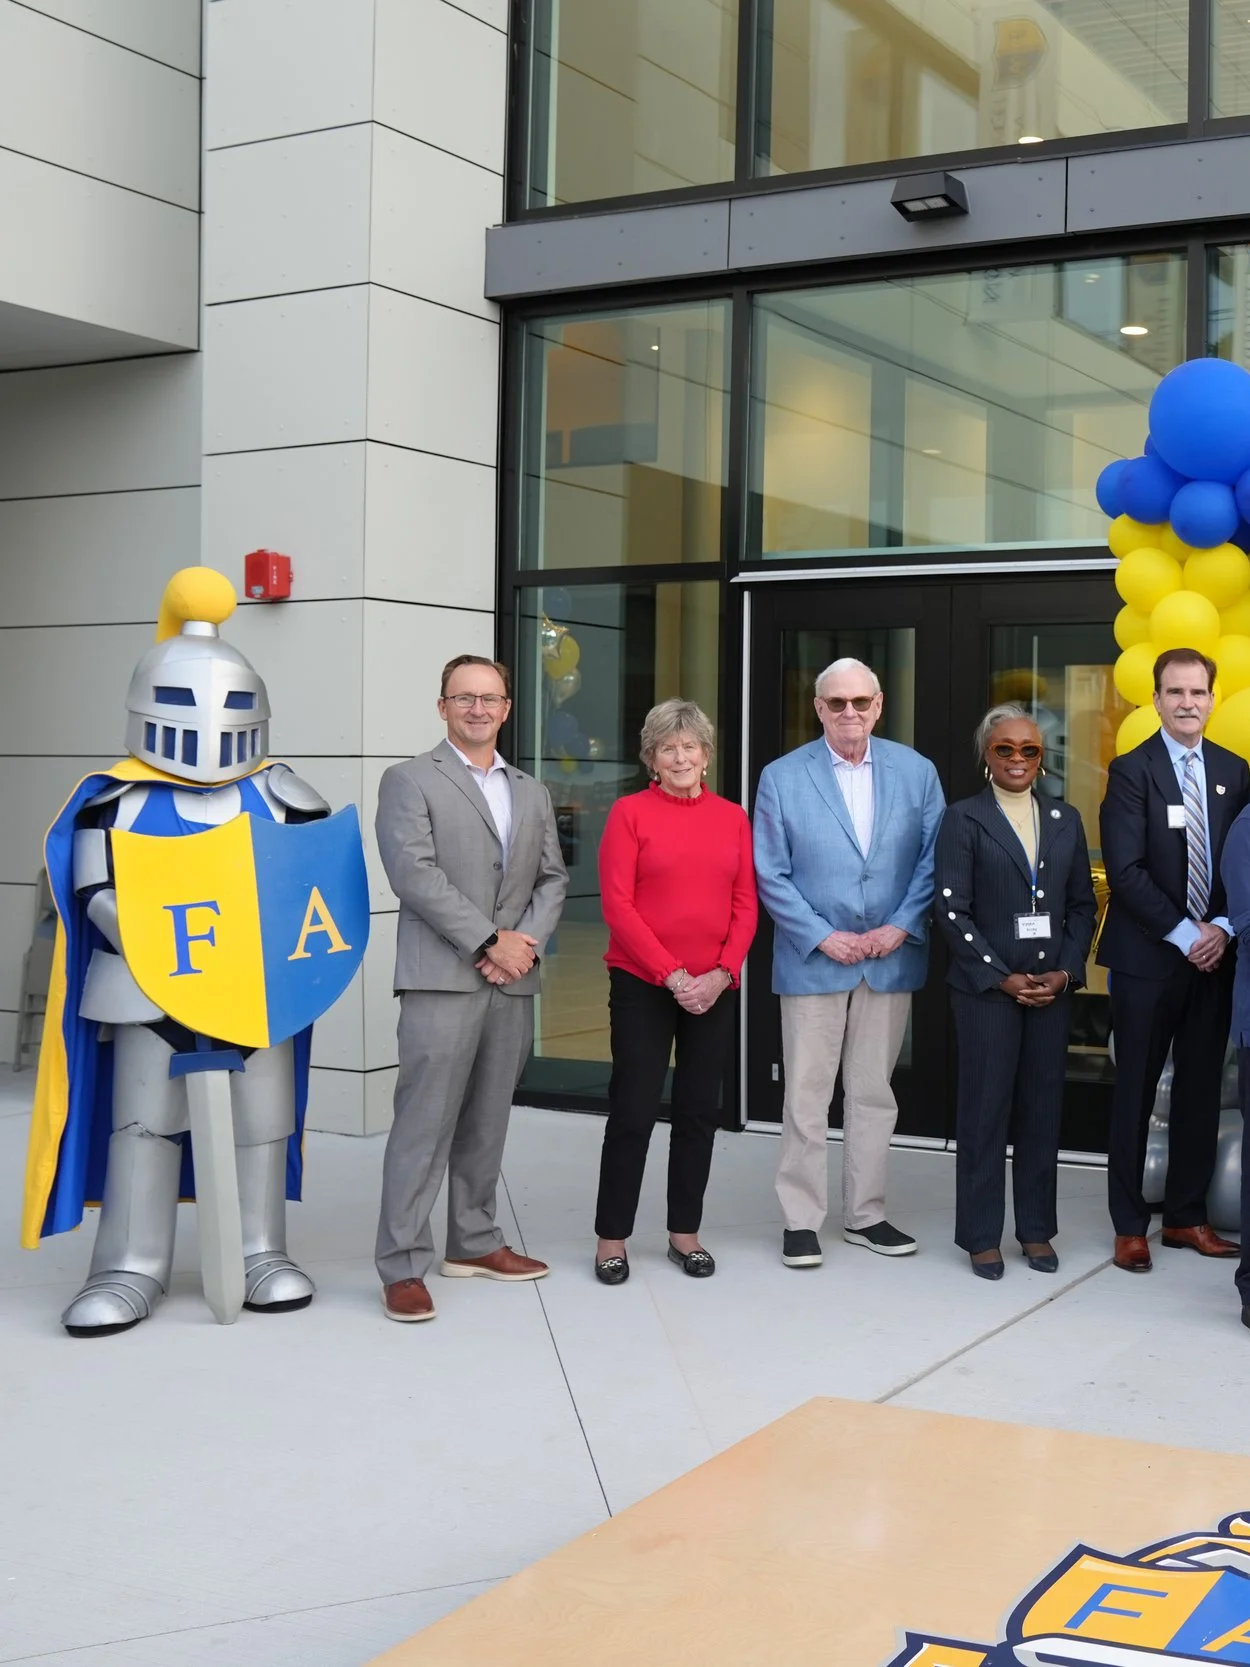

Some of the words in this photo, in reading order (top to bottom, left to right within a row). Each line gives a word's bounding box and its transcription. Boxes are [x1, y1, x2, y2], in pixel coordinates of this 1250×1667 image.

[162, 900, 221, 977] F
[287, 886, 352, 961] A
[1063, 1582, 1168, 1629] F
